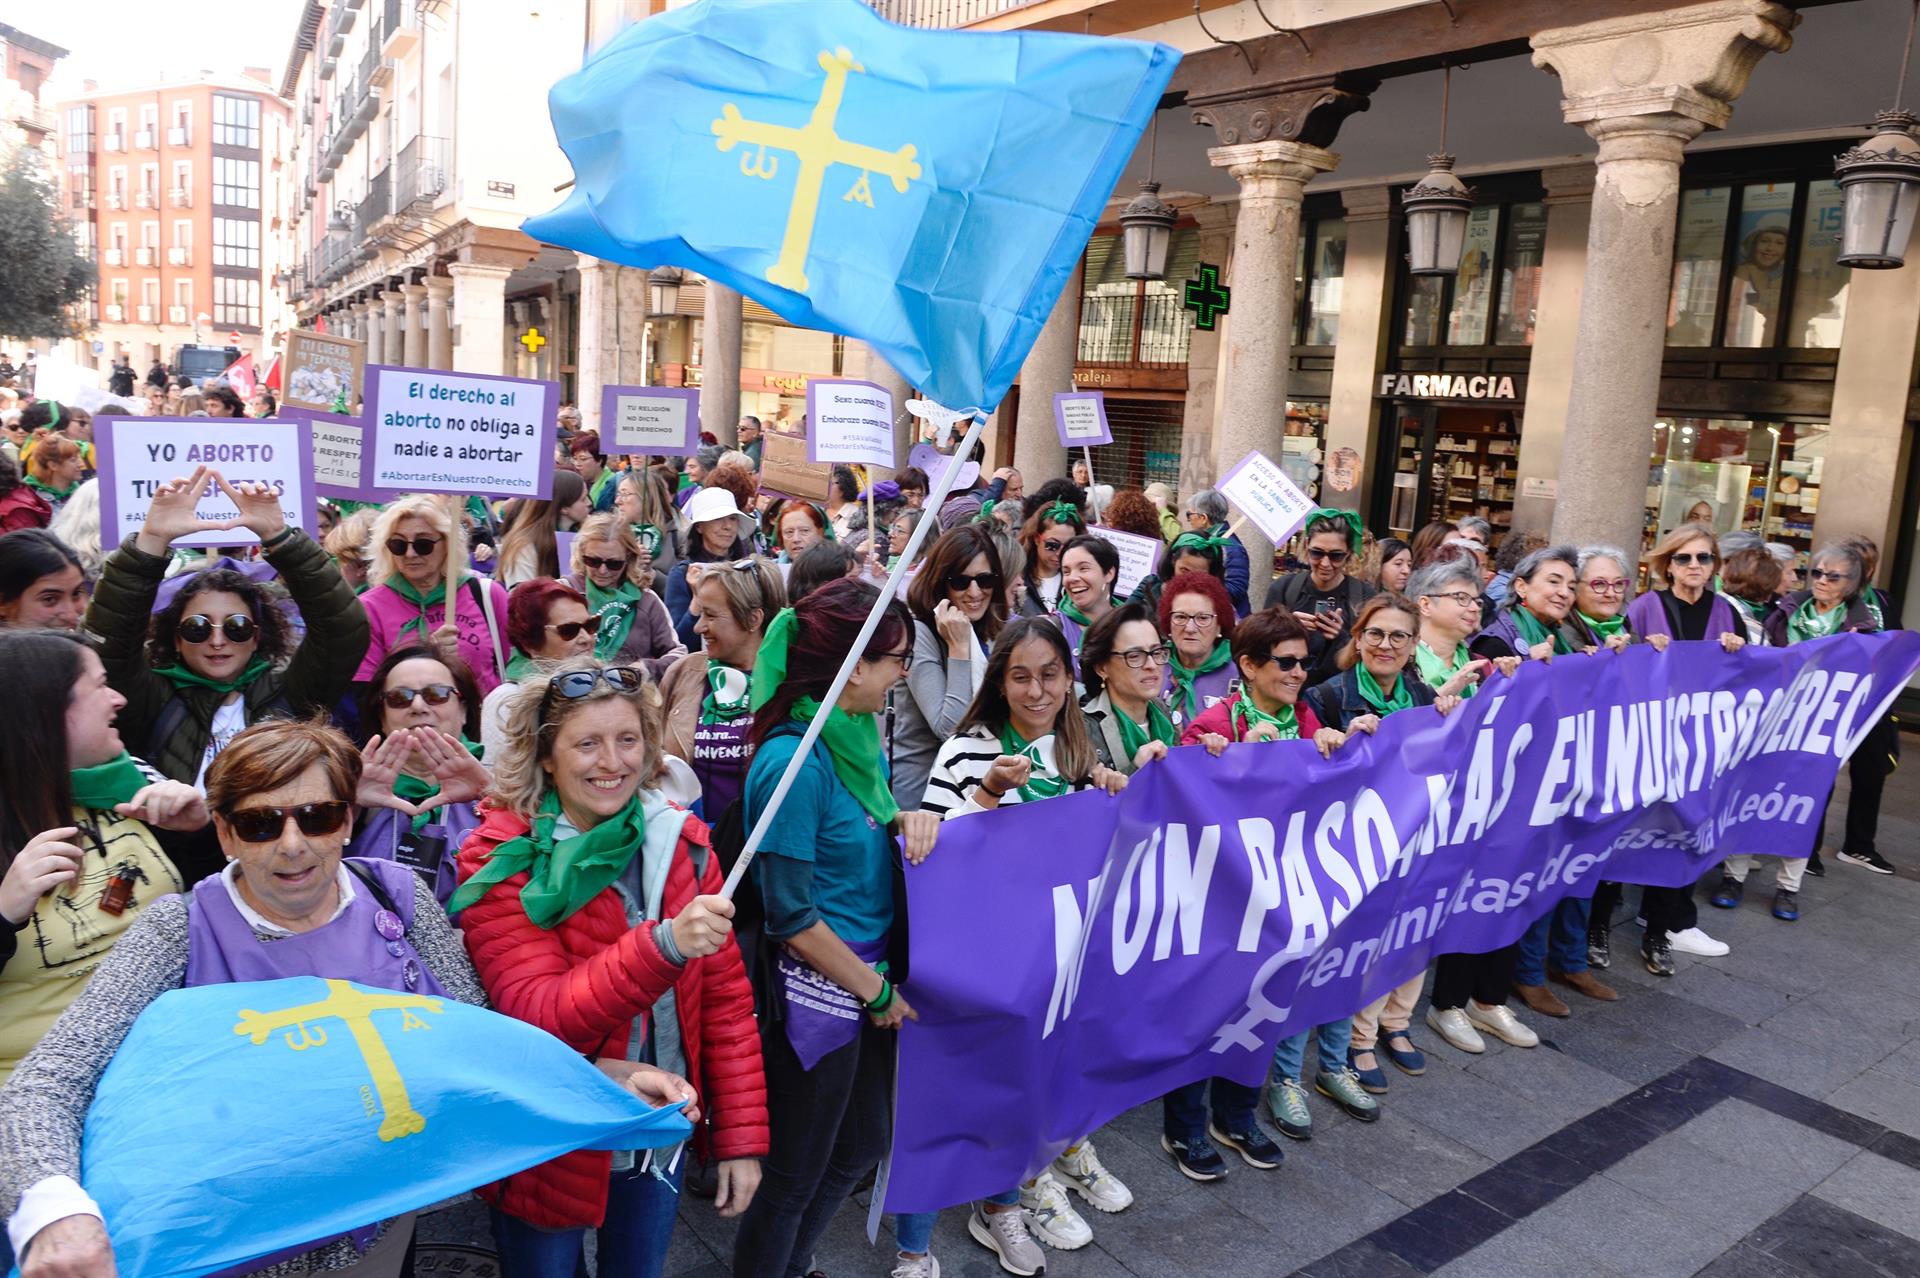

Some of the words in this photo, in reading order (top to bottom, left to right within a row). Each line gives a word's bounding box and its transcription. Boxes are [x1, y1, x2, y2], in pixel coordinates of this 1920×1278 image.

[408, 382, 424, 399] El
[429, 384, 495, 405] derecho
[500, 391, 515, 407] al
[1380, 374, 1515, 399] FARMACIA
[384, 411, 441, 430] aborto
[446, 418, 465, 432] no
[470, 417, 520, 439] obliga
[525, 423, 534, 436] a
[321, 433, 363, 446] ABORTO
[394, 440, 438, 458] nadie
[443, 446, 453, 459] a
[458, 444, 523, 463] abortar
[147, 443, 176, 463] YO
[186, 444, 274, 463] ABORTO
[381, 471, 532, 487] #AbortarEsNuestroDerecho
[1727, 782, 1817, 828] León
[1112, 826, 1221, 976] UN
[1236, 788, 1401, 954] PASO
[1529, 707, 1596, 827] EN
